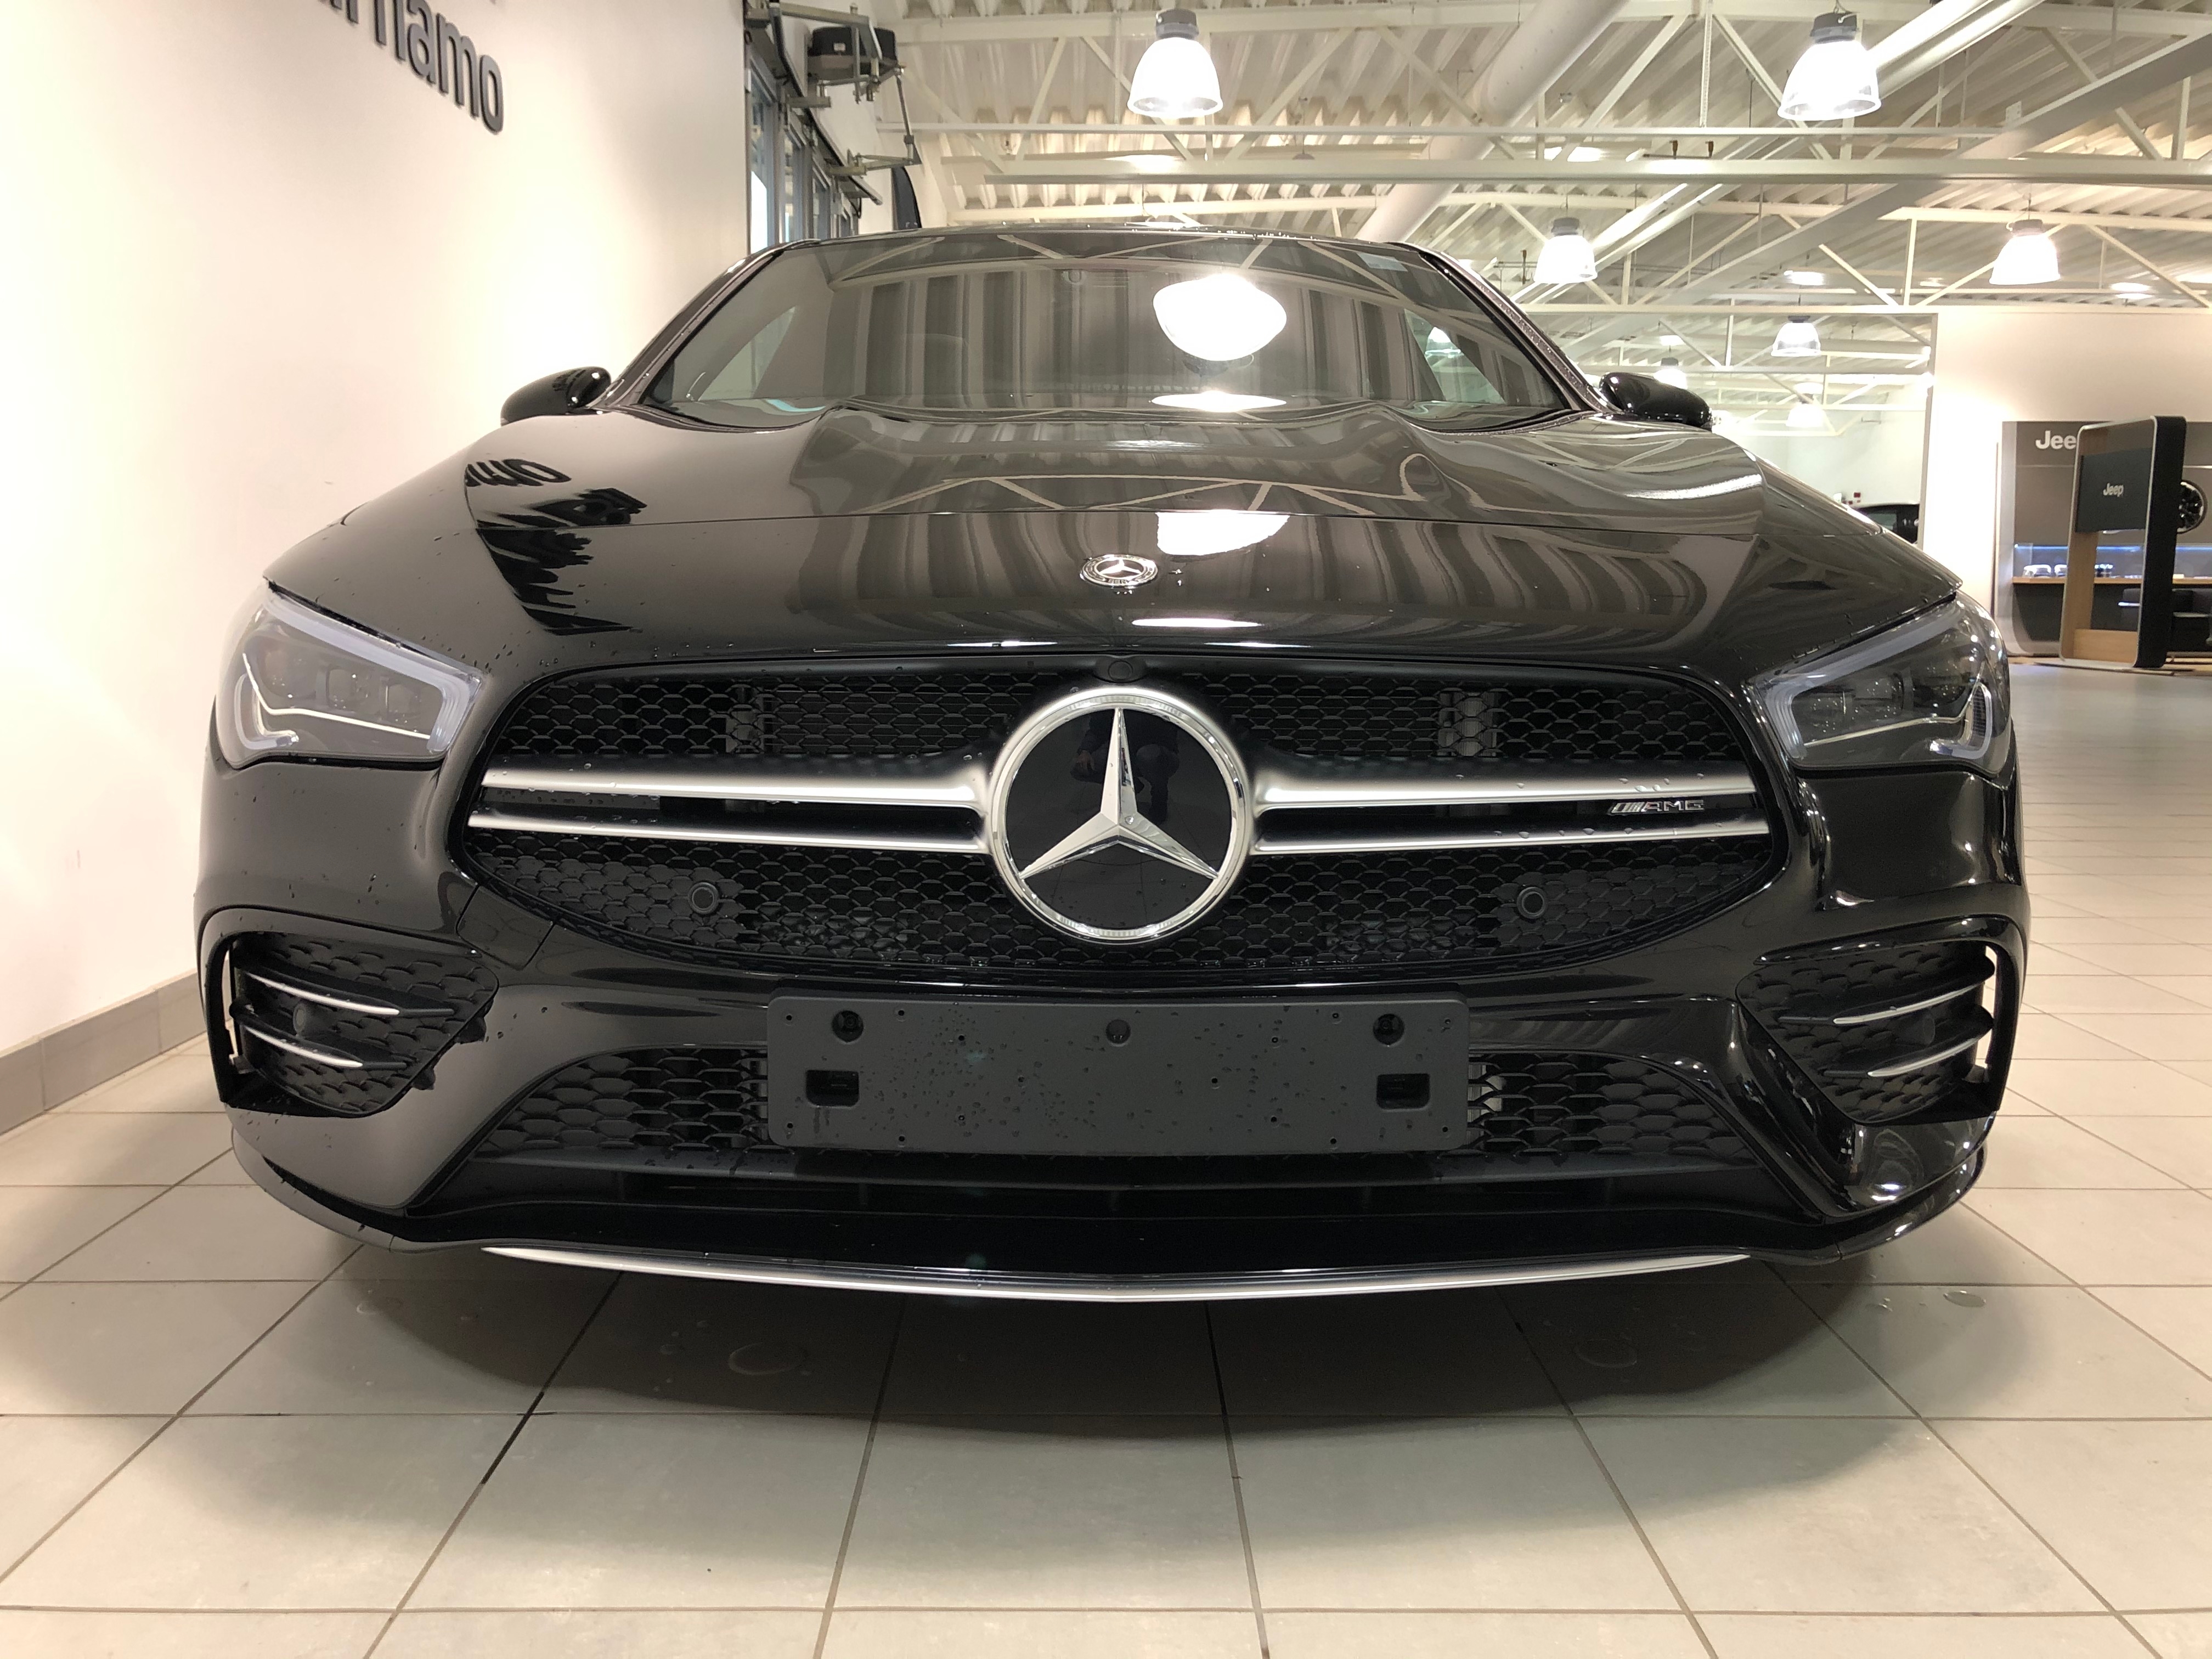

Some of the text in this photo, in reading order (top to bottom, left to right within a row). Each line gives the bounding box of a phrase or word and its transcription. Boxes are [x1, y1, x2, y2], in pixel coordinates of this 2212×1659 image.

[2035, 430, 2076, 449] Jee
[2103, 483, 2124, 496] Jeep
[1640, 799, 1704, 812] AMG
